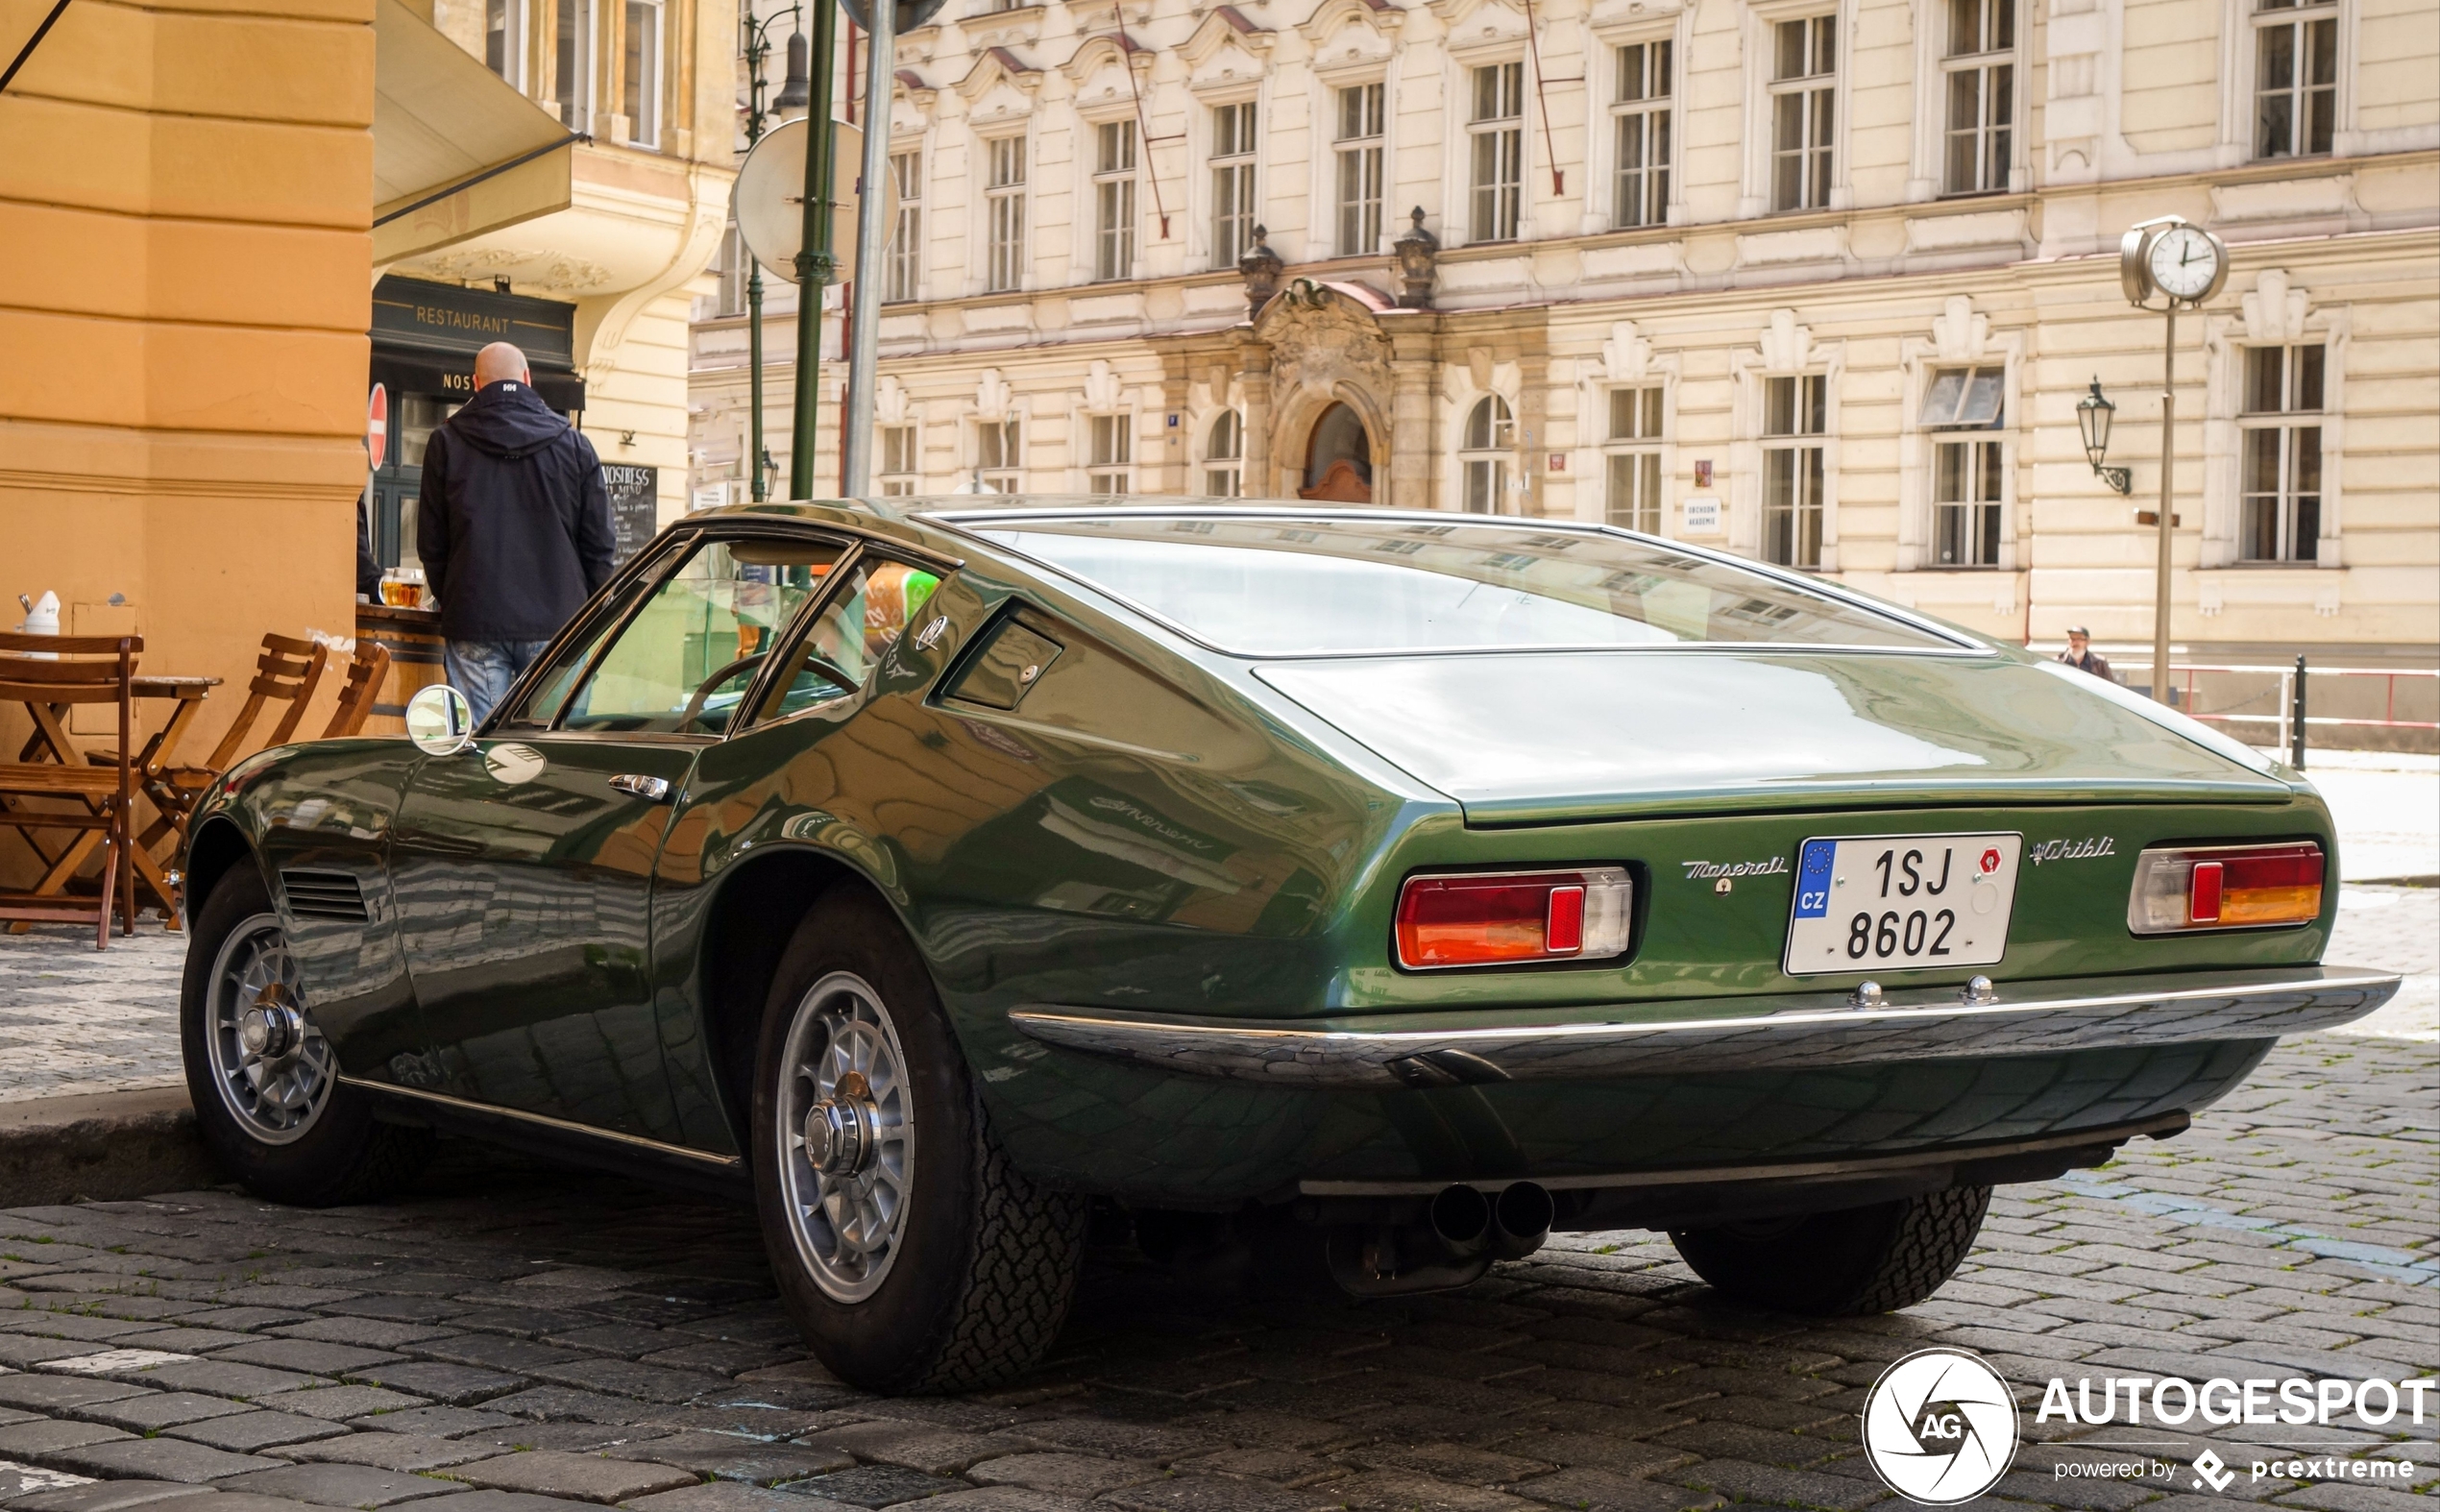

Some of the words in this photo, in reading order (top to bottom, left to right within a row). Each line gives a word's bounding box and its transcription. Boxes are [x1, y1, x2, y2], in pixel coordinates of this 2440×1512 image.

[416, 305, 509, 333] RESTAURANT
[1689, 517, 1716, 525] AKADEMIE
[2043, 837, 2115, 860] Ghibli
[1682, 856, 1789, 879] Maserati
[1875, 847, 1952, 898] 1SJ
[1801, 891, 1824, 910] CZ
[1847, 909, 1955, 960] 8602
